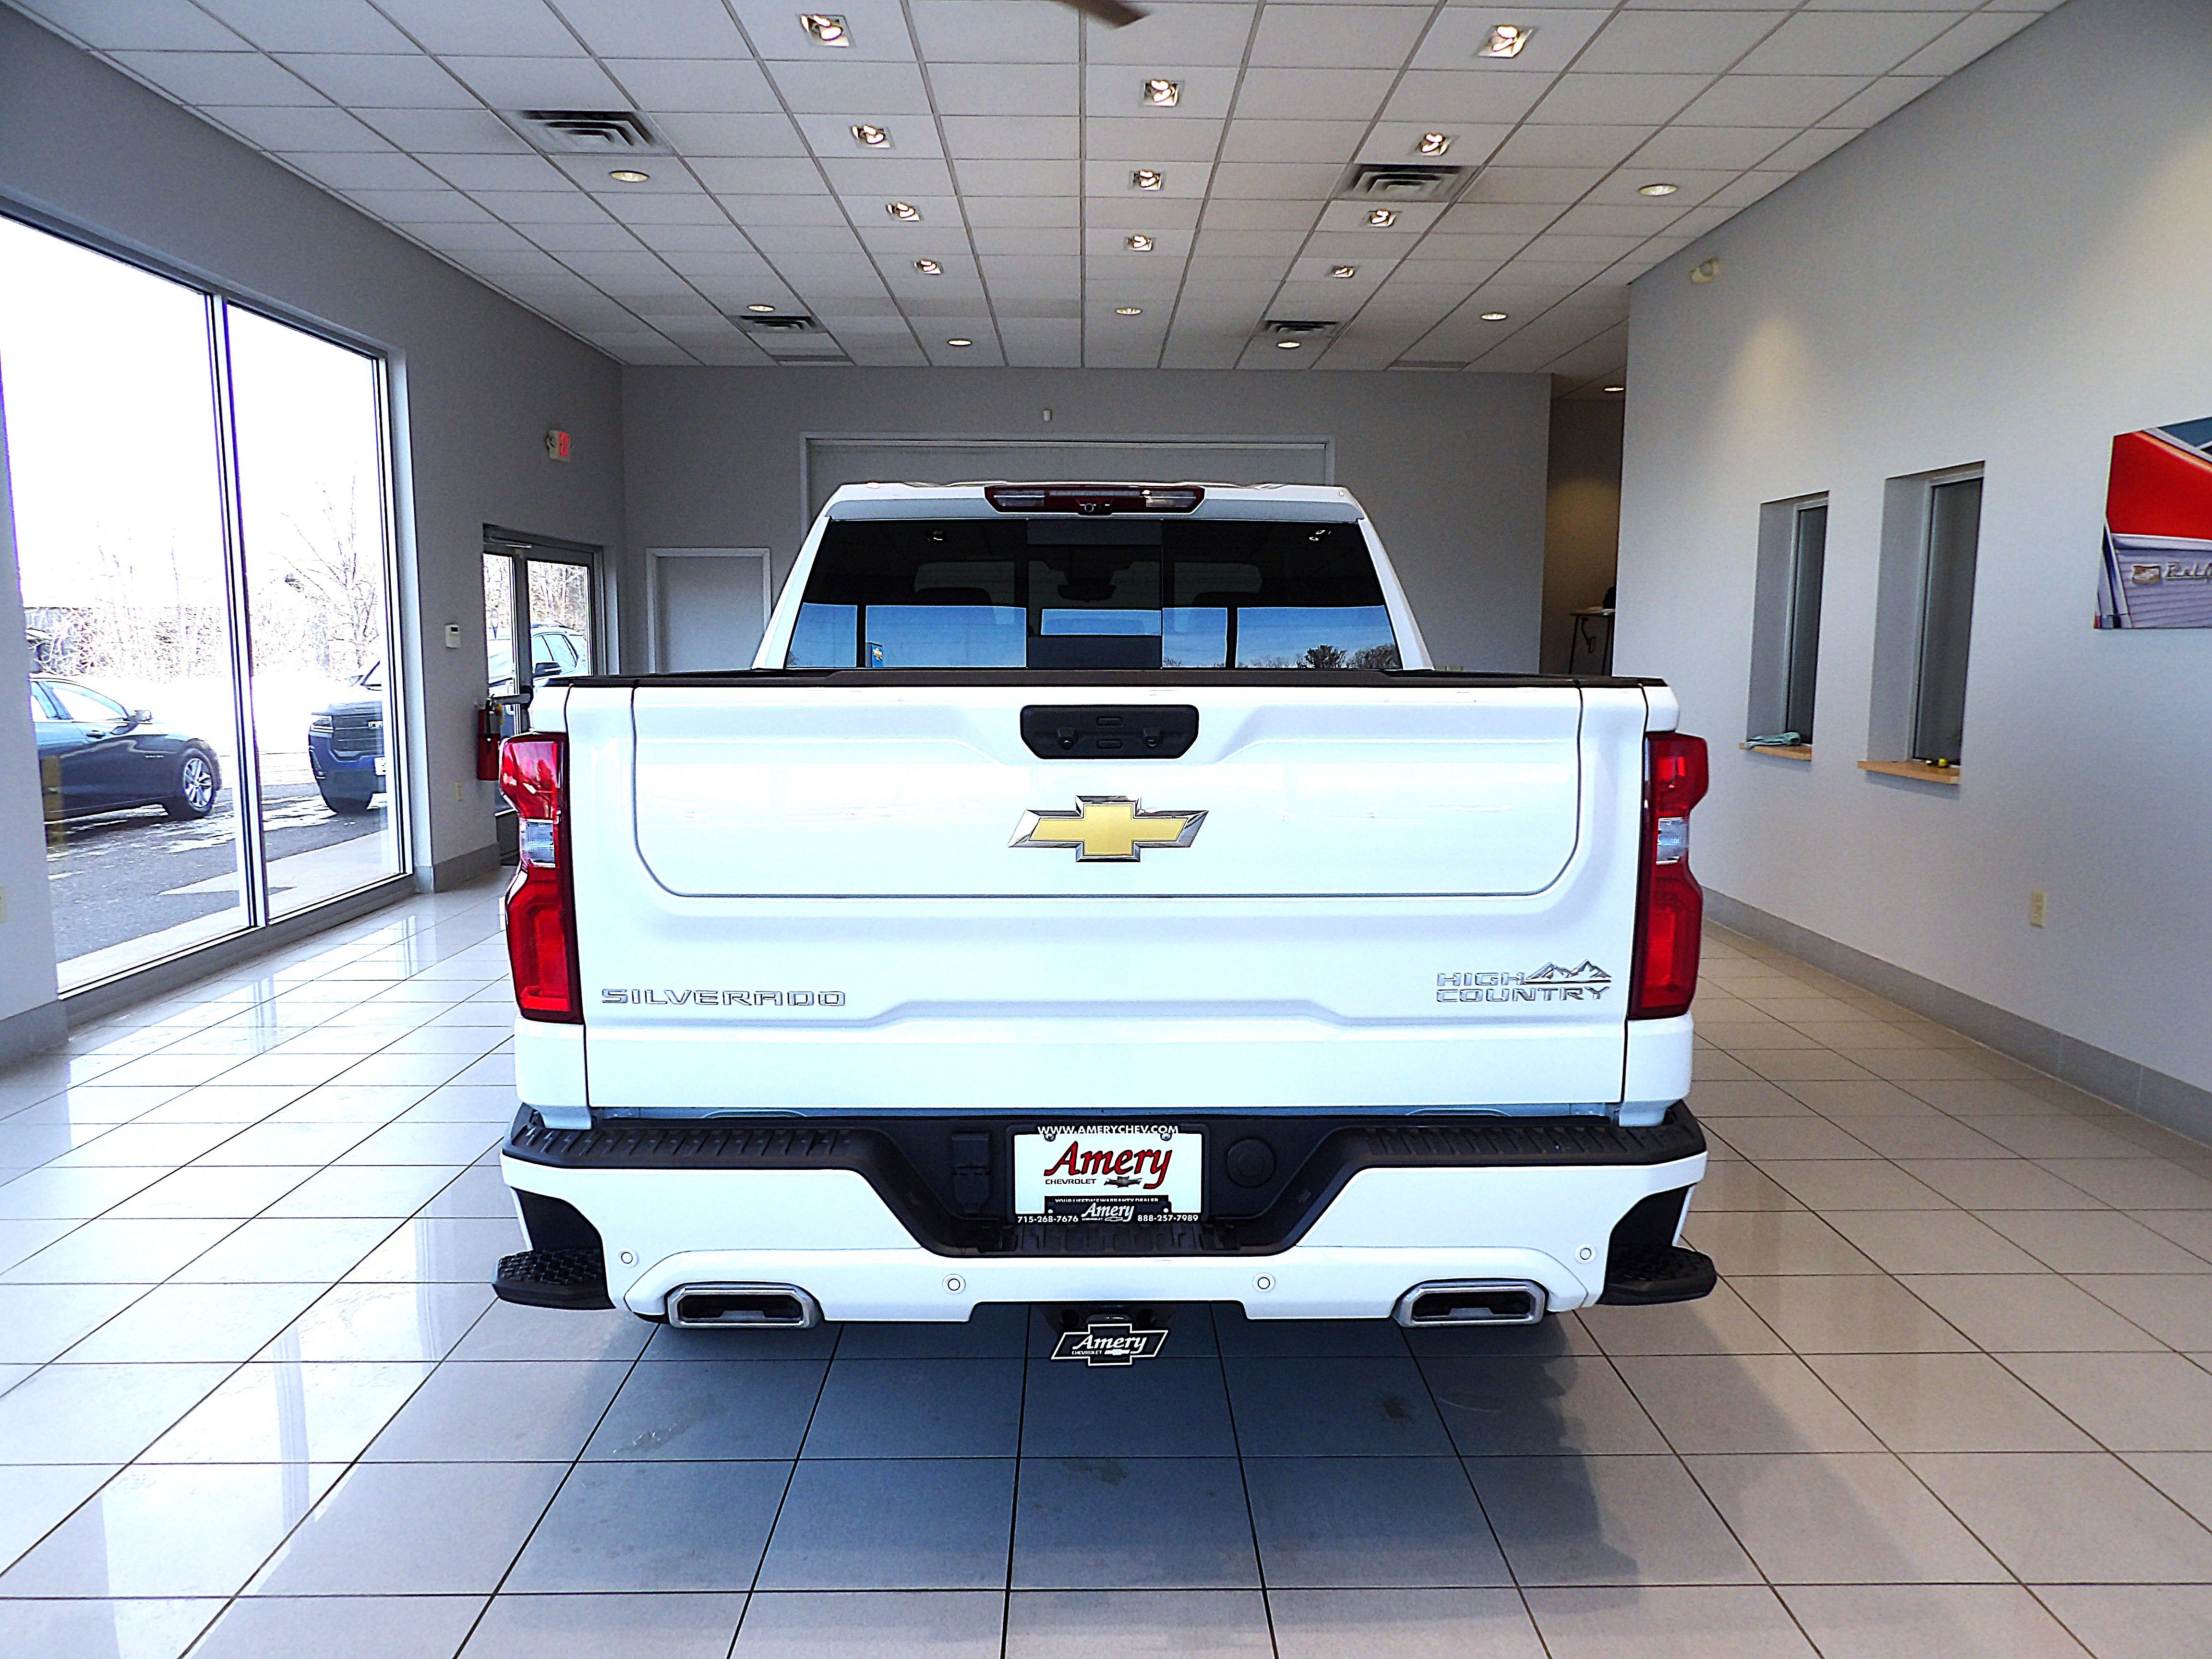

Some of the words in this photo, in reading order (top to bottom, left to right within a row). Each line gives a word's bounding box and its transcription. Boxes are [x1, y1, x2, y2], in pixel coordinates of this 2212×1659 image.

[1437, 972, 1525, 986] HIGH
[601, 988, 846, 1007] SILVERADO
[1436, 986, 1610, 1002] COUNTRY
[1037, 1125, 1179, 1134] WWW.AMERYCHEV.COM
[1044, 1141, 1173, 1190] Amery
[1081, 1202, 1134, 1222] Amery
[1072, 1334, 1147, 1354] Amery
